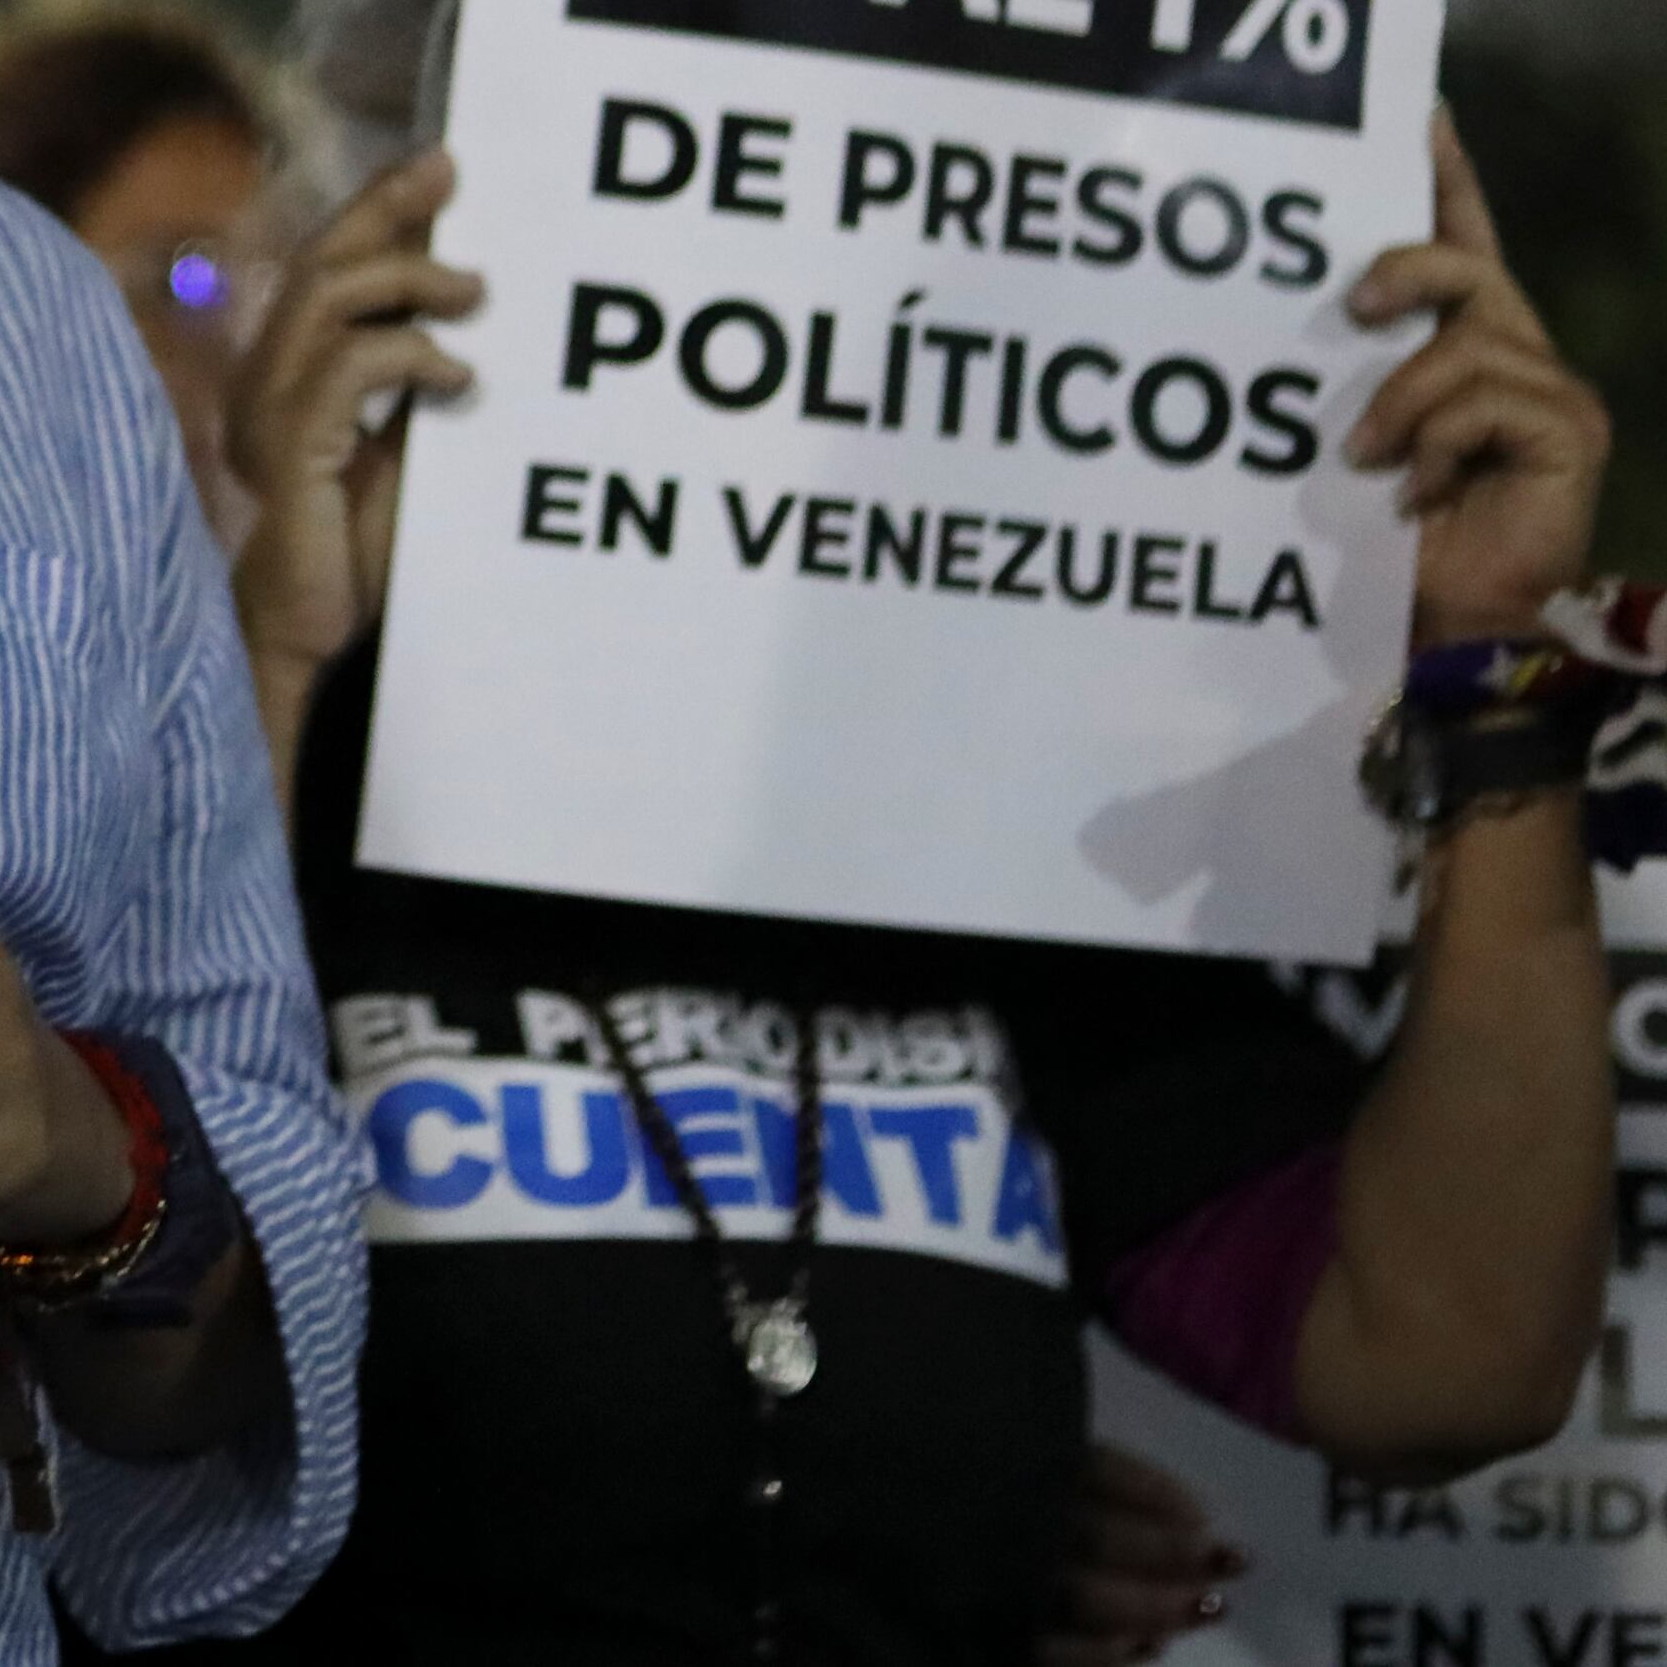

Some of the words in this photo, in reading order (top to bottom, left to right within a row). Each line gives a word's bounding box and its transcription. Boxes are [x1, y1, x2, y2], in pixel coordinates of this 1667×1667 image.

[590, 96, 793, 221] DE
[835, 128, 1332, 291] PRESOS
[560, 282, 1324, 478] POLÍTICOS
[518, 462, 680, 558] EN
[722, 484, 1324, 631] VENEZUELA
[330, 990, 479, 1077] EL
[368, 1078, 1065, 1256] CUENTA
[1494, 1468, 1667, 1544] SID
